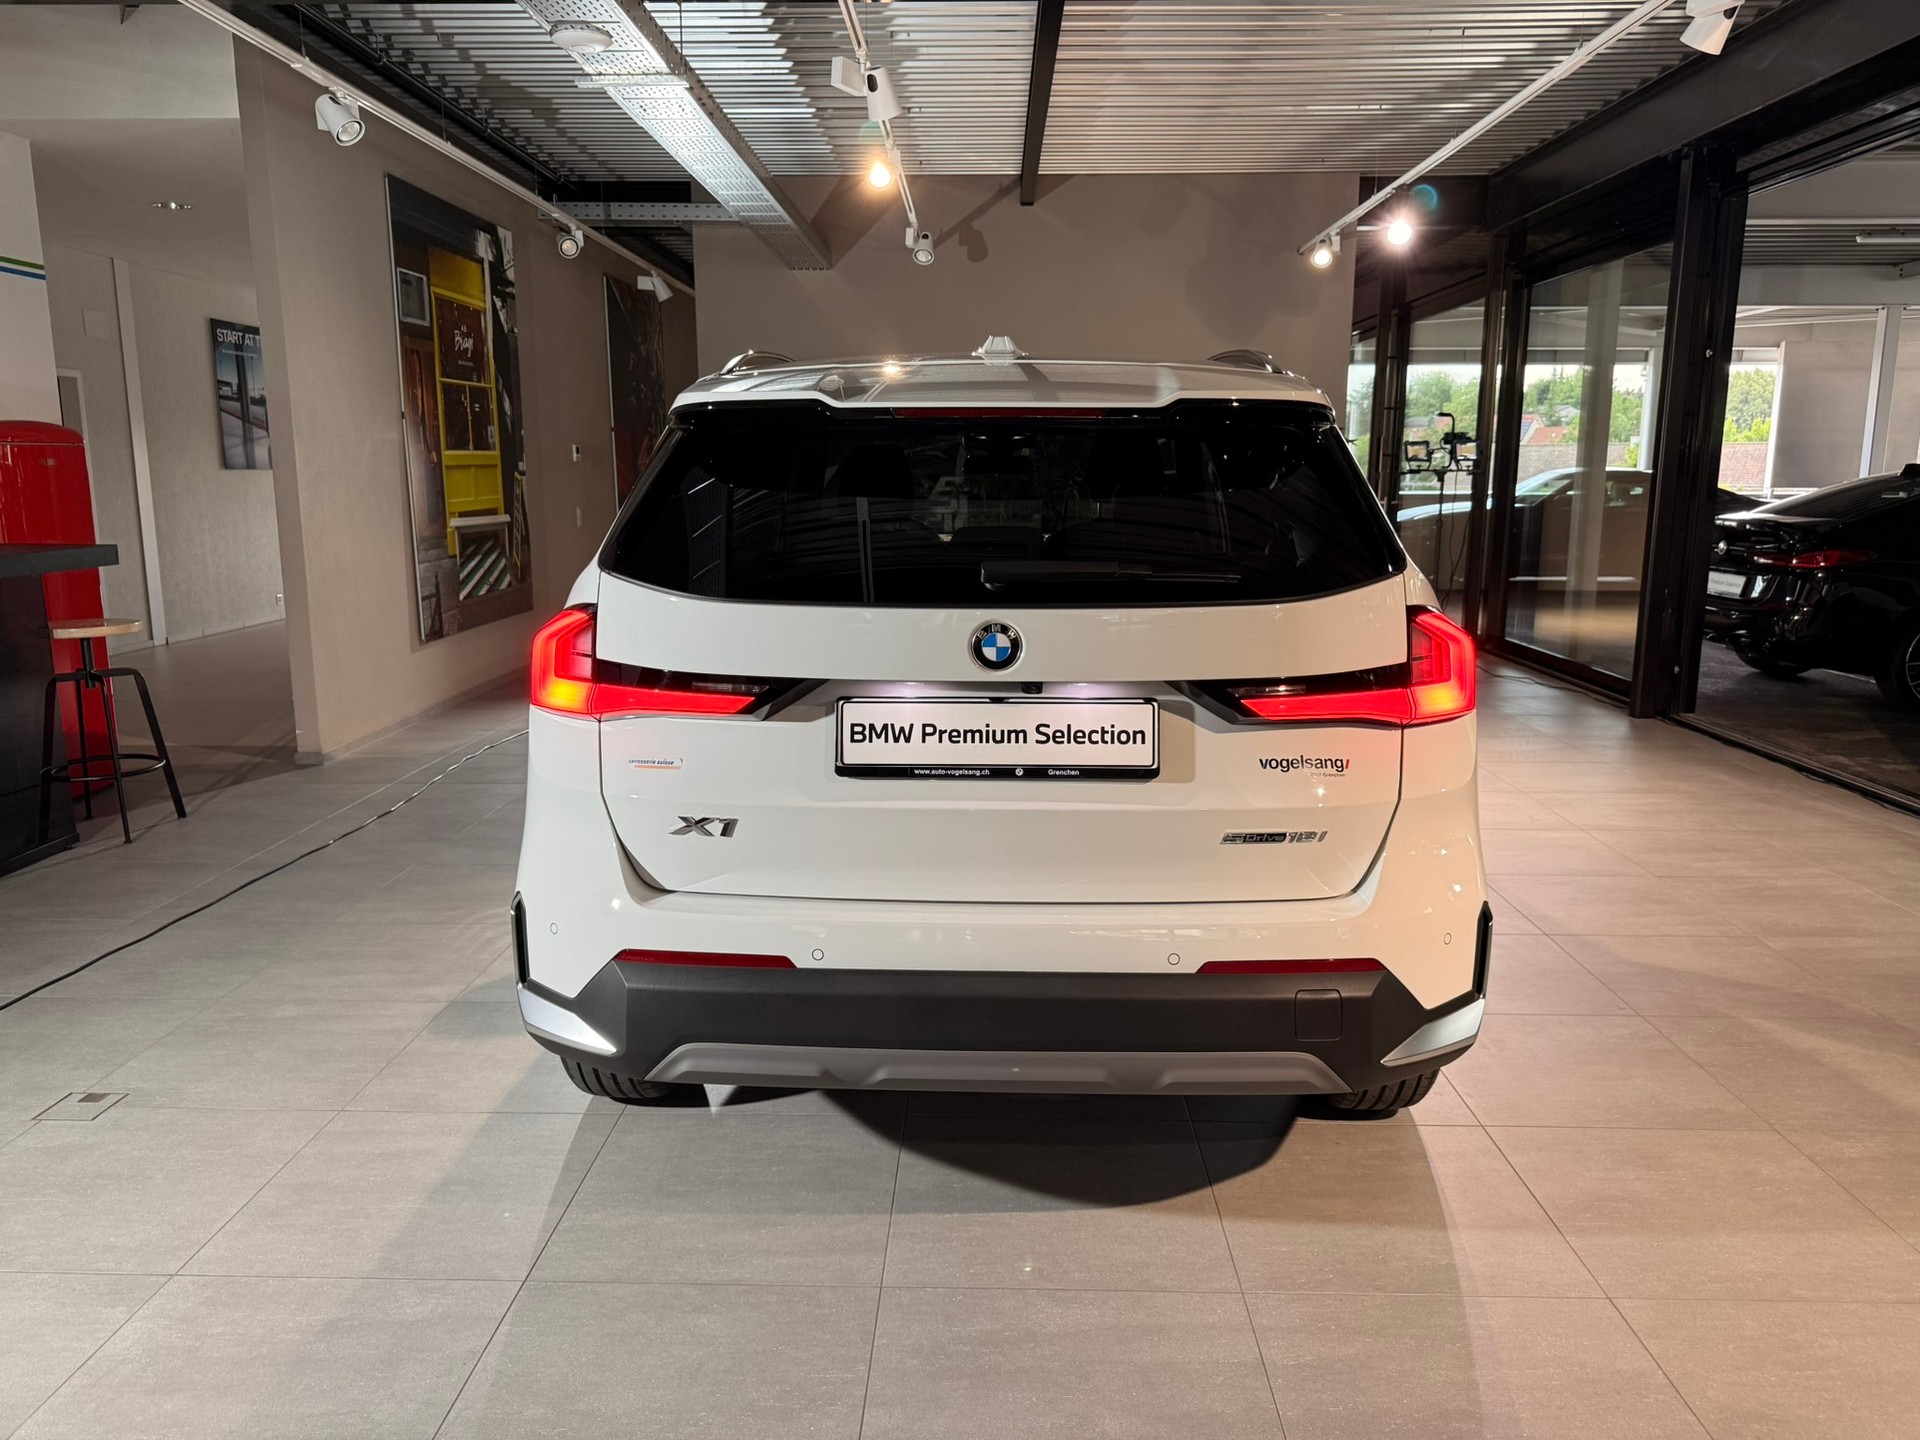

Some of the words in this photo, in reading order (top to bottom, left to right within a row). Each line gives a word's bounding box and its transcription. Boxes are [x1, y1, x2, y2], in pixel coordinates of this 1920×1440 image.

[216, 328, 243, 345] START
[244, 333, 254, 346] AT
[976, 624, 1017, 640] BMW
[850, 723, 914, 744] BMW
[921, 723, 1028, 744] Premium
[1035, 723, 1146, 745] Selection
[914, 768, 990, 776] www.auto-vogelsang.ch
[1048, 768, 1080, 776] Grenchen
[668, 816, 739, 838] X1
